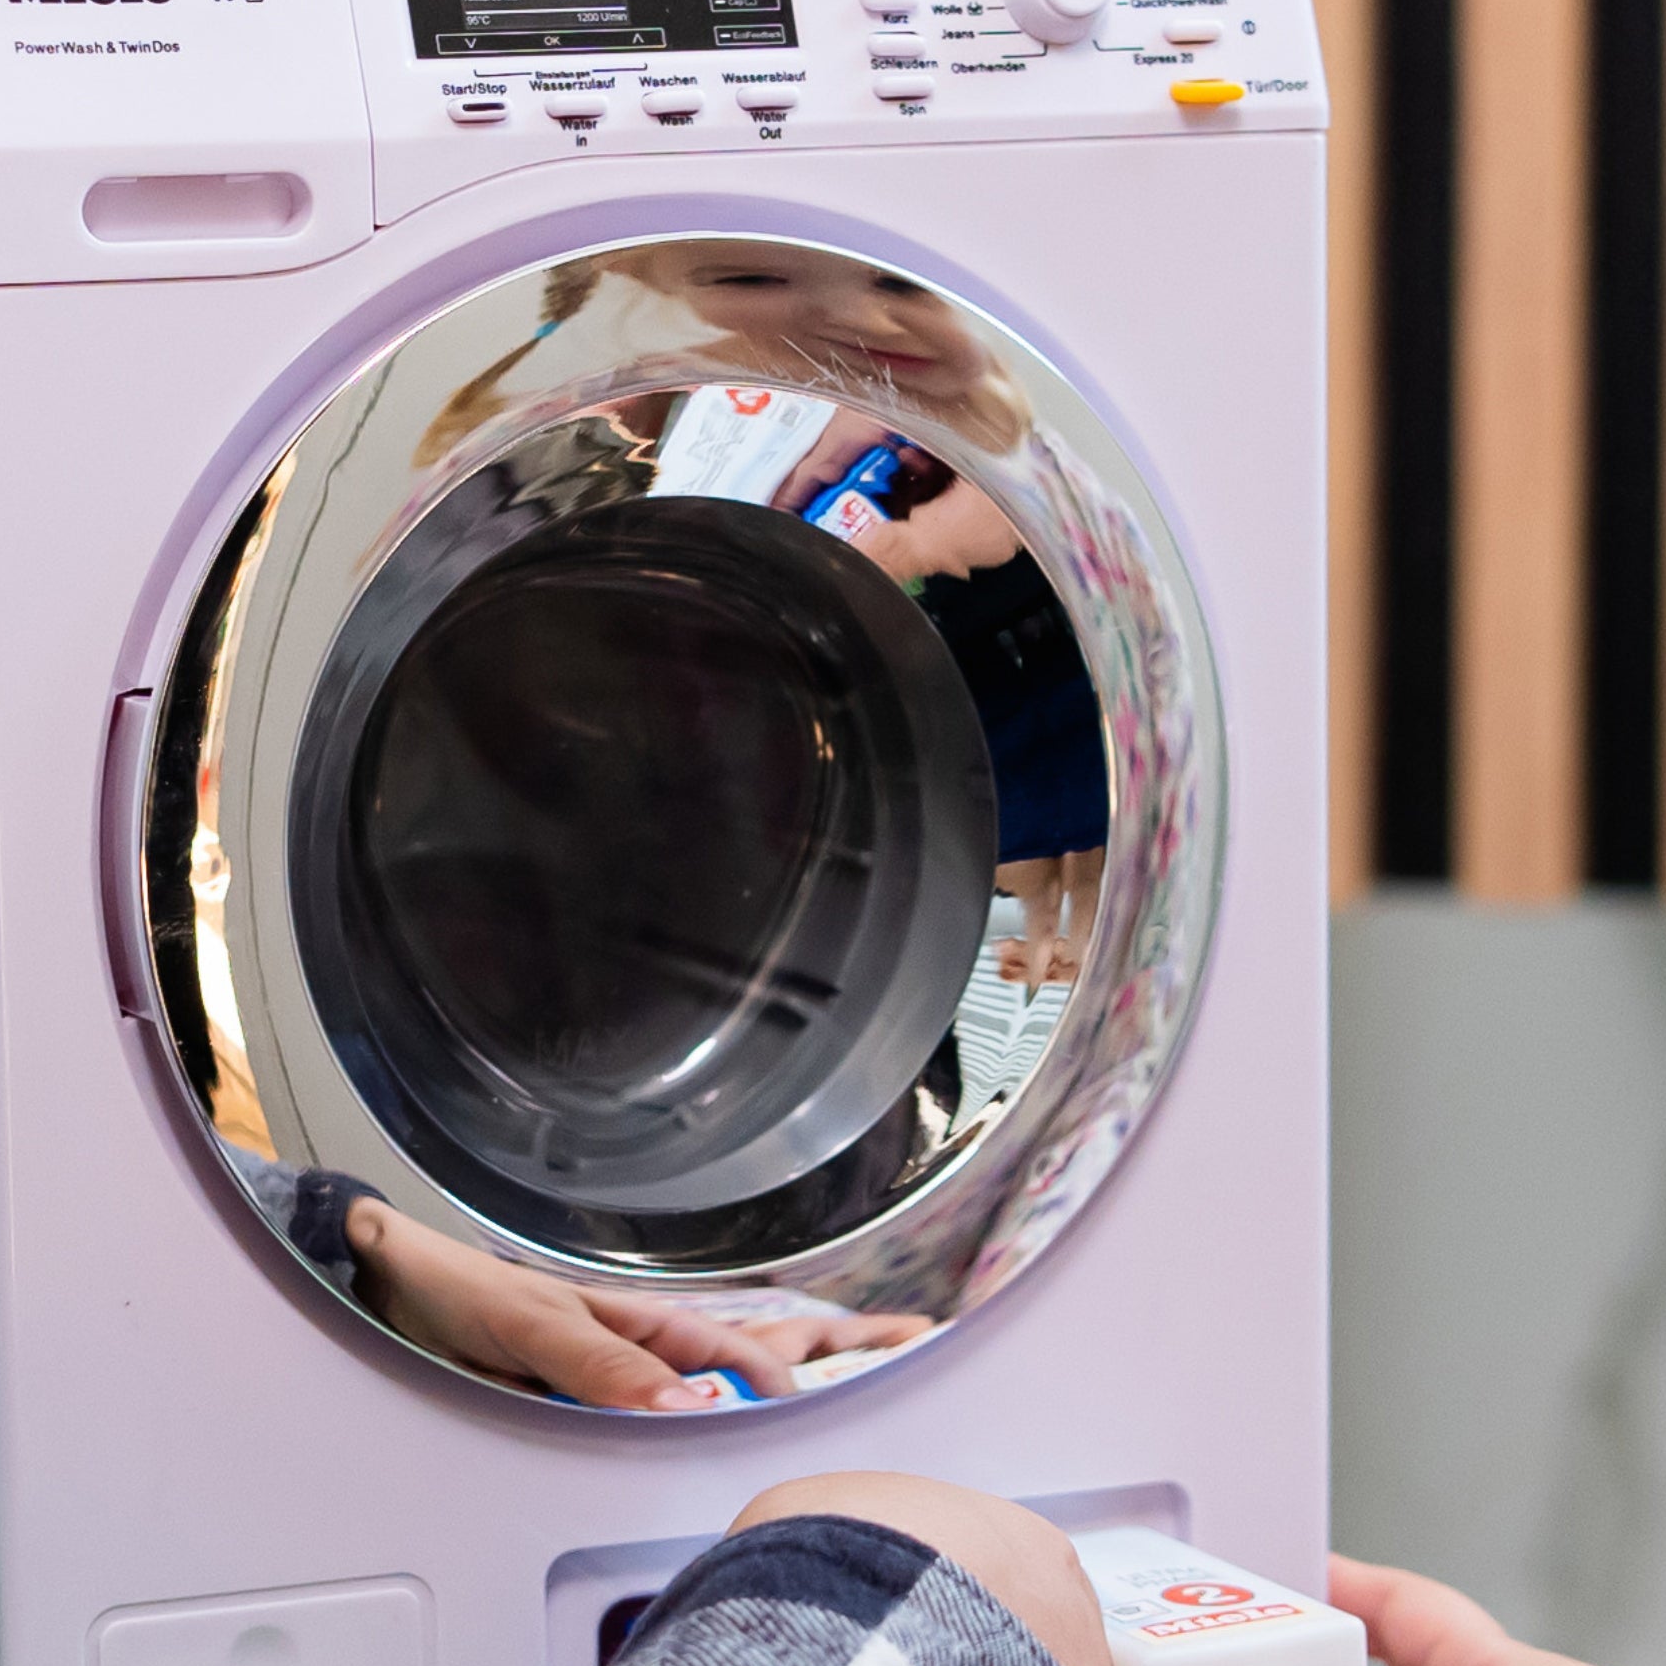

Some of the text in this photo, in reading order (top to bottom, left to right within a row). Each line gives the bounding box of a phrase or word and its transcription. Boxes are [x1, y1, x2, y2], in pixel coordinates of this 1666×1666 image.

[932, 5, 962, 15] Wolle
[577, 13, 599, 22] 1200
[883, 13, 909, 24] Kurz
[544, 36, 561, 46] OK
[941, 29, 975, 40] Jeans
[106, 41, 116, 54] &
[871, 58, 939, 70] Schleudern
[1134, 53, 1194, 66] Express 20
[951, 61, 1026, 74] Oberhemden
[638, 75, 697, 87] Waschen
[721, 71, 806, 84] Wasserablauf
[442, 83, 507, 96] Start/Stop
[529, 77, 616, 92] Wasserzulauf
[1246, 80, 1308, 93] Tür/Door
[899, 103, 926, 116] Spin
[658, 115, 694, 126] Wash
[750, 111, 787, 123] Water
[559, 119, 597, 131] Water
[759, 127, 782, 140] Out
[1181, 1584, 1240, 1605] 2
[1144, 1604, 1296, 1636] Miele
